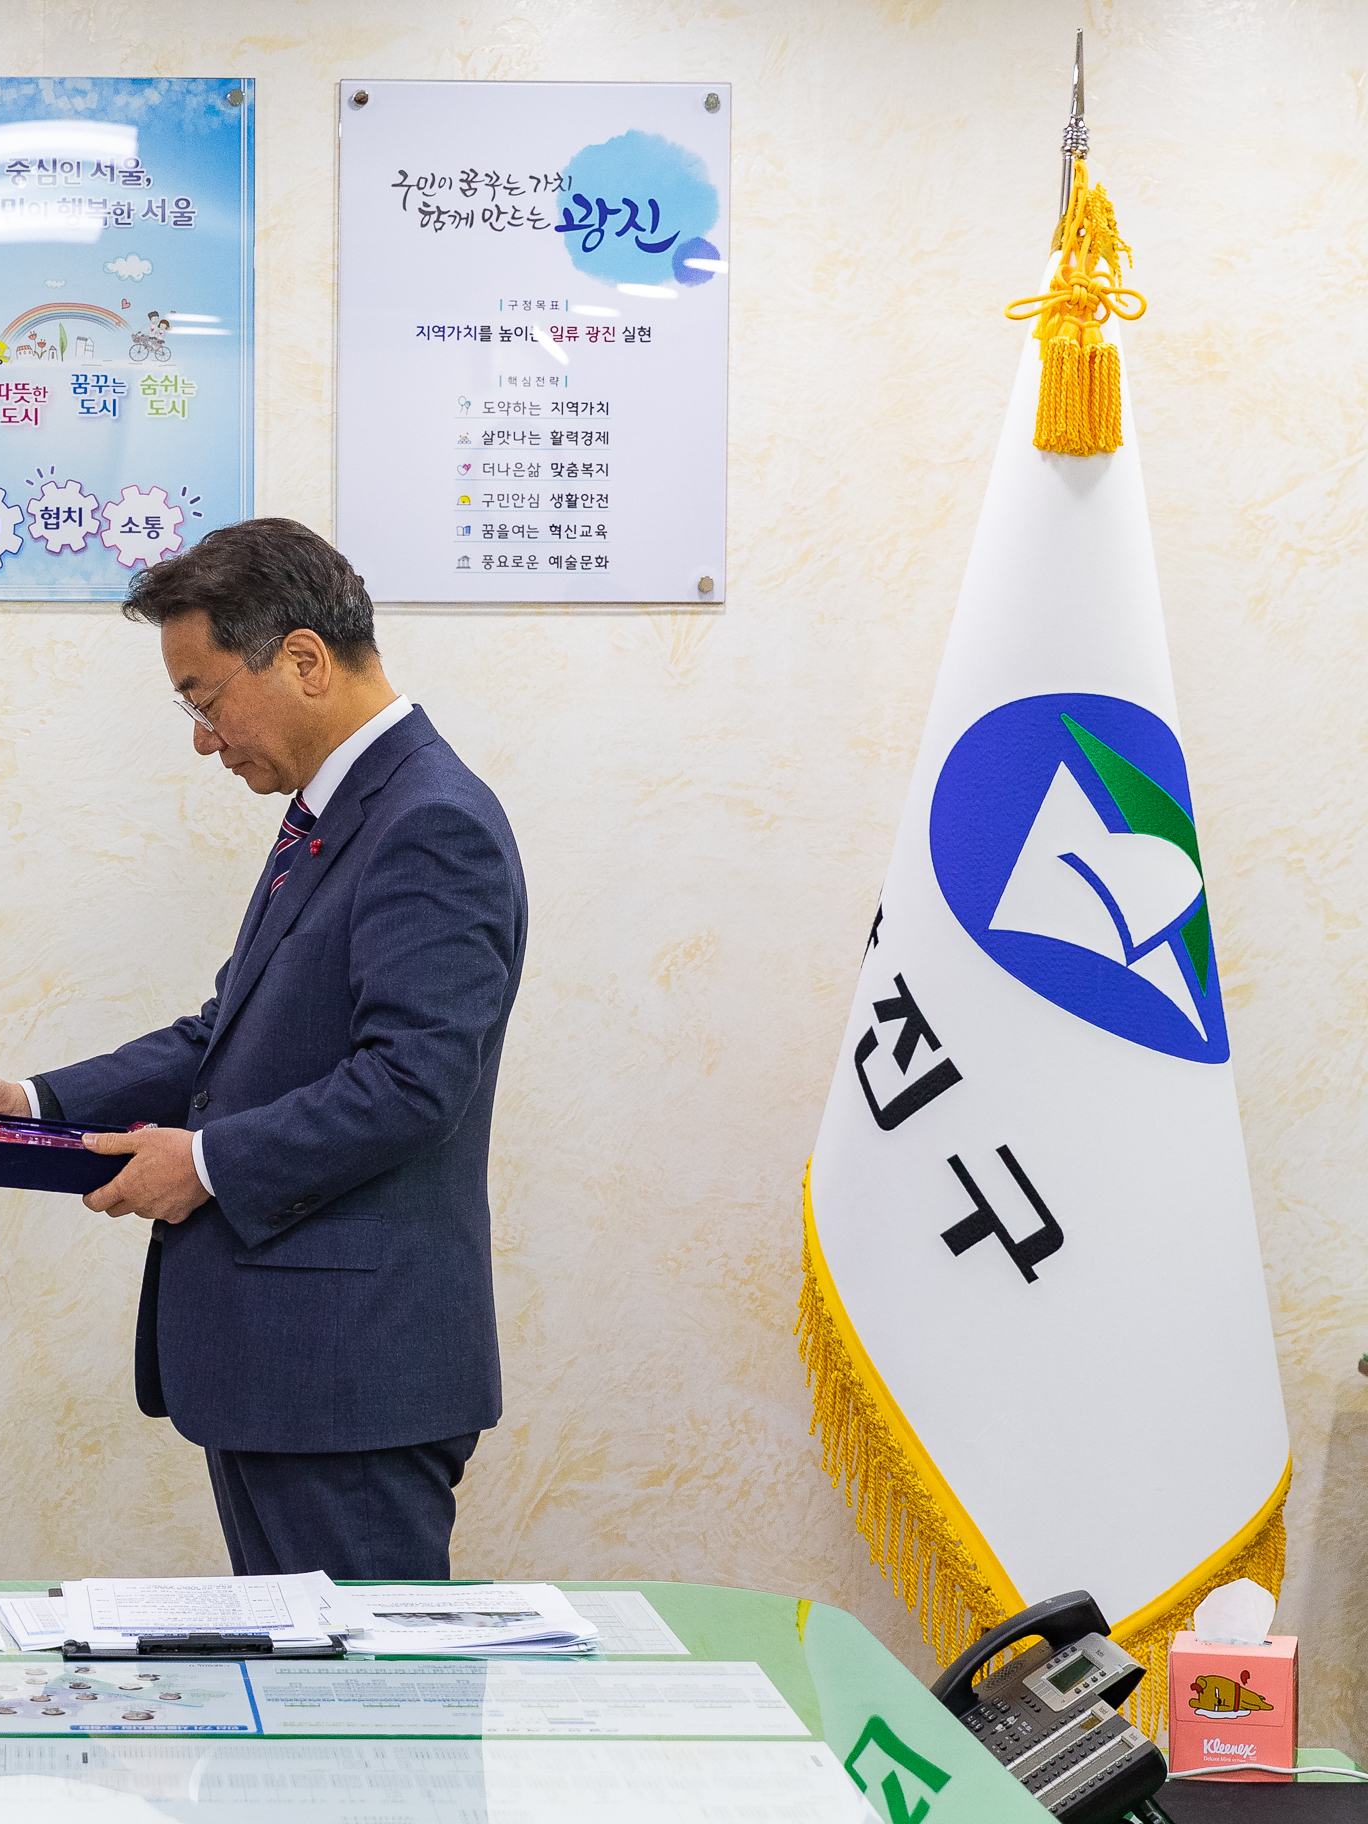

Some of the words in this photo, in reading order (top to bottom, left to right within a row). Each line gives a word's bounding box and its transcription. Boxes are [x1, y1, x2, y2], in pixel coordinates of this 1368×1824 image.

[6, 158, 81, 186] 중심인
[90, 156, 152, 187] 서울,
[392, 169, 453, 210] 구민이
[459, 169, 526, 201] 꿈꾸는
[529, 172, 573, 193] 가치
[57, 197, 135, 227] 행복한
[141, 197, 196, 227] 서울
[417, 202, 475, 232] 함께
[482, 205, 552, 231] 만드는
[554, 193, 680, 252] 광진
[508, 300, 560, 311] 구정목표
[416, 325, 492, 342] 지역가치를
[550, 325, 579, 342] 일류
[585, 325, 616, 342] 광진
[622, 325, 651, 342] 실현
[71, 374, 126, 395] 꿈꾸는
[140, 375, 196, 395] 숨쉬는
[508, 376, 559, 387] 핵심전략
[1, 407, 39, 426] 도시
[79, 399, 117, 418] 도시
[148, 399, 187, 418] 도시
[482, 400, 542, 416] 도약하는
[551, 400, 609, 416] 지역가치
[482, 430, 542, 446] 살맛나는
[550, 430, 609, 446] 활력경제
[482, 461, 541, 478] 더나은삶
[551, 461, 609, 478] 맞춤복지
[482, 492, 540, 509] 구민안심
[550, 492, 609, 509] 생활안전
[39, 506, 83, 528] 협치
[120, 516, 164, 540] 소통
[481, 524, 539, 540] 꿈을여는
[549, 524, 608, 540] 혁신교육
[481, 554, 539, 571] 풍요로운
[548, 554, 609, 571] 예술문화
[854, 892, 1064, 1284] 진구
[1203, 1738, 1257, 1759] Kleenex
